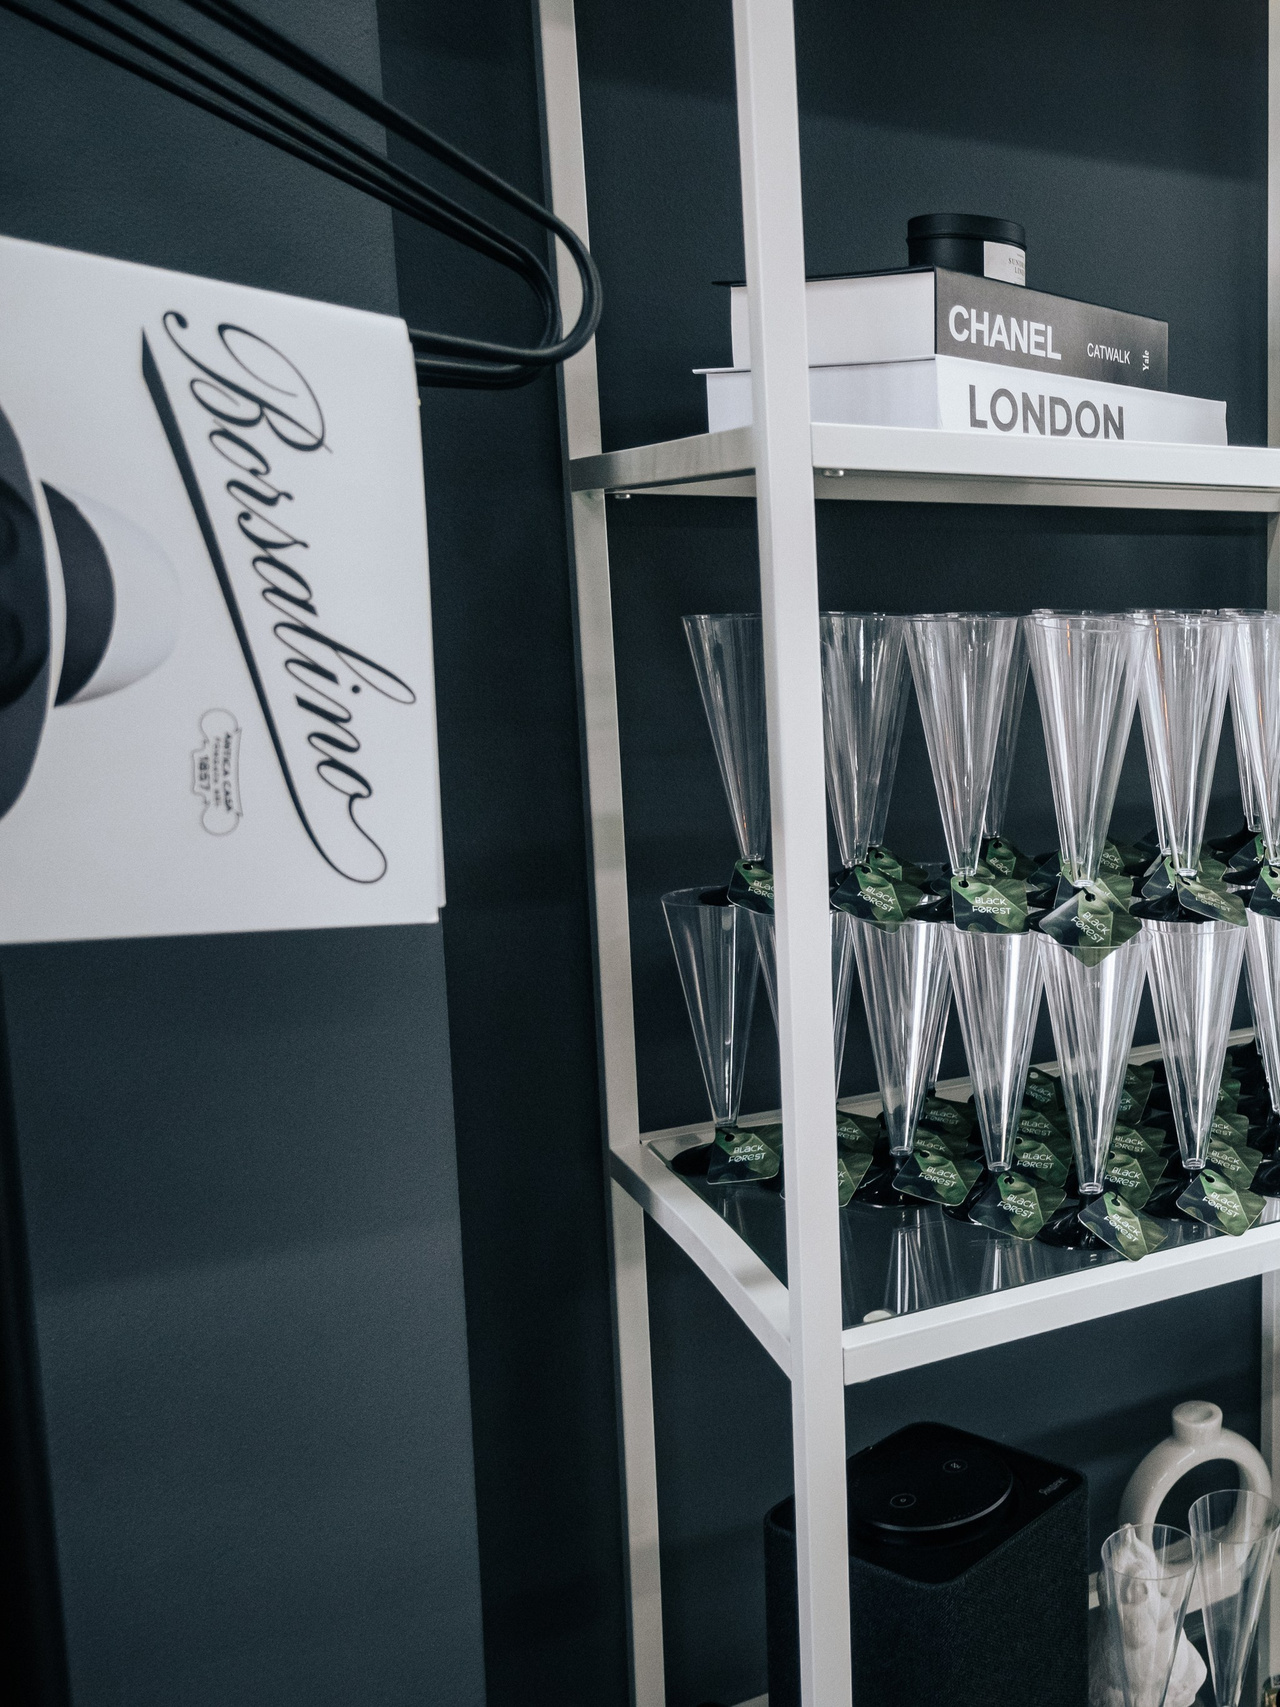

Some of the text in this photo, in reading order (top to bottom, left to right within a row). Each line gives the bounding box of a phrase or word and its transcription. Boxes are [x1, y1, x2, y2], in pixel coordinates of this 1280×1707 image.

[948, 304, 1150, 372] CHANEL CATWALK Yale
[968, 384, 1125, 440] LONDON
[142, 310, 416, 883] Borsalino
